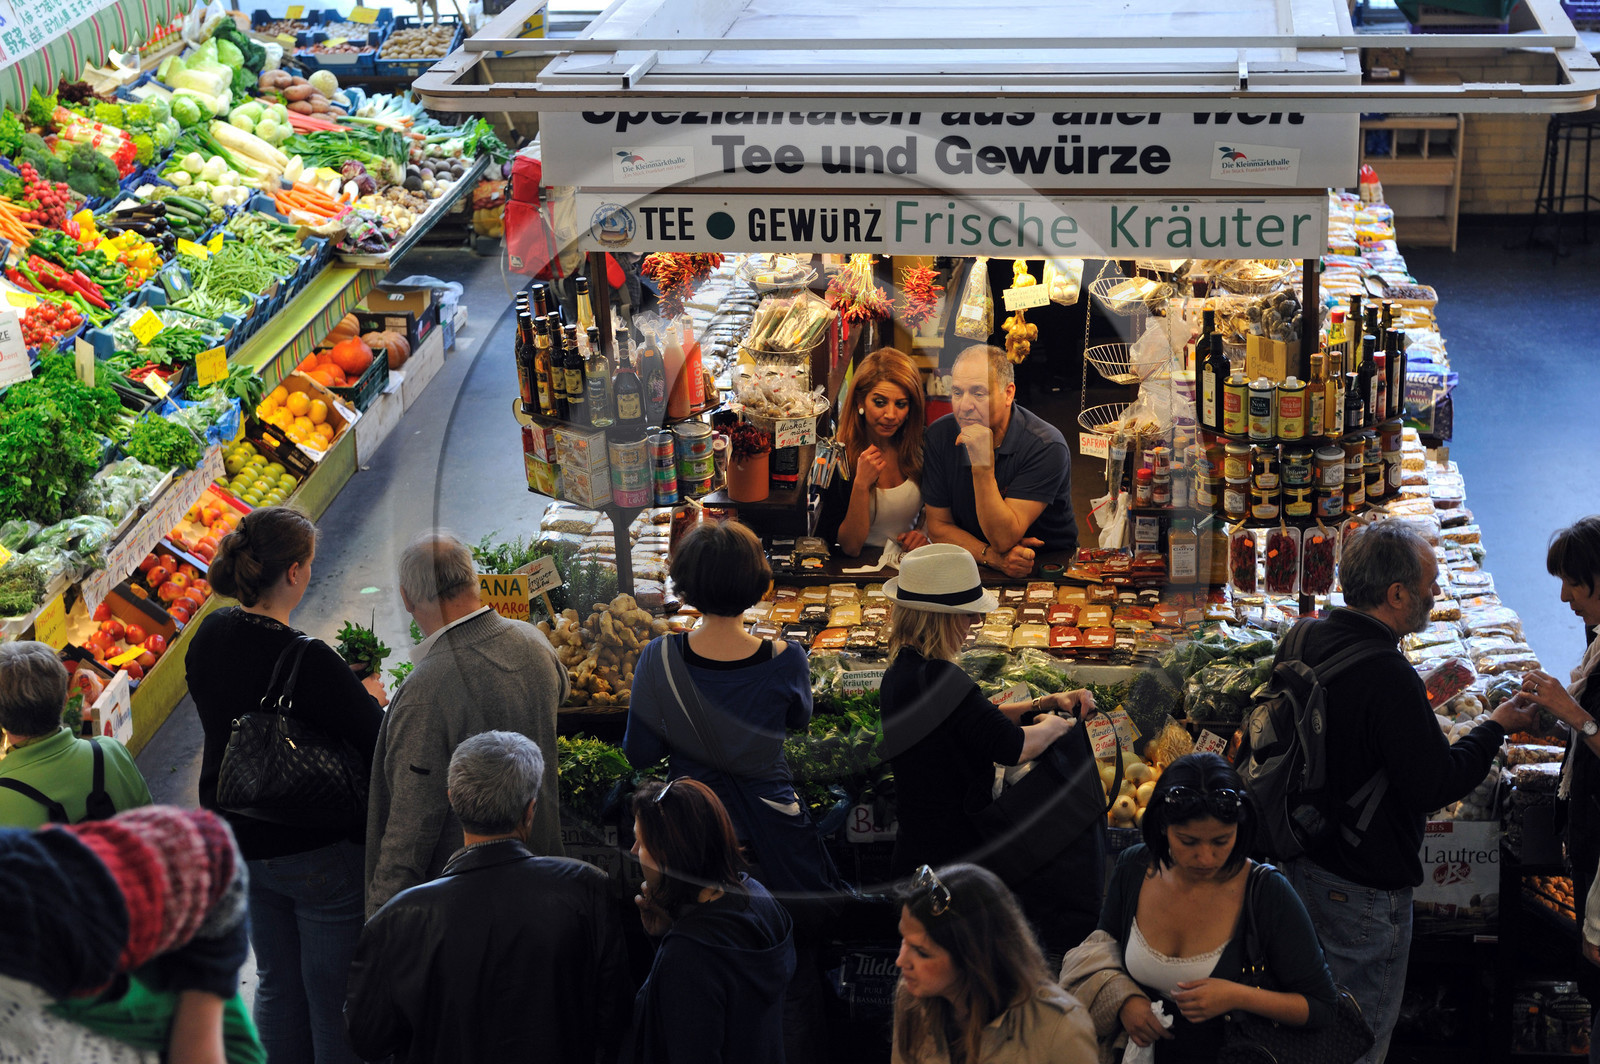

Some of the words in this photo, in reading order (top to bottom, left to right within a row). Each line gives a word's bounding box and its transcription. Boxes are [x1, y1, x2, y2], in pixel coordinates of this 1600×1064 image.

[711, 135, 804, 174] Tee
[821, 135, 918, 174] und
[934, 134, 1172, 175] Gewürze
[635, 156, 686, 171] Kleinmarkthalle
[1236, 158, 1290, 168] Kleinmarkthalle
[640, 207, 695, 241] TEE
[896, 200, 1079, 247] Frische
[1111, 204, 1312, 248] Kräuter
[693, 360, 704, 398] SIROP
[1406, 371, 1439, 384] ilda
[1081, 437, 1107, 449] SAFRAN
[488, 602, 529, 614] MAROC
[843, 671, 884, 680] Gemischte
[843, 680, 873, 688] Kräuter
[1425, 847, 1498, 864] Lautrec
[850, 953, 899, 976] Tilda
